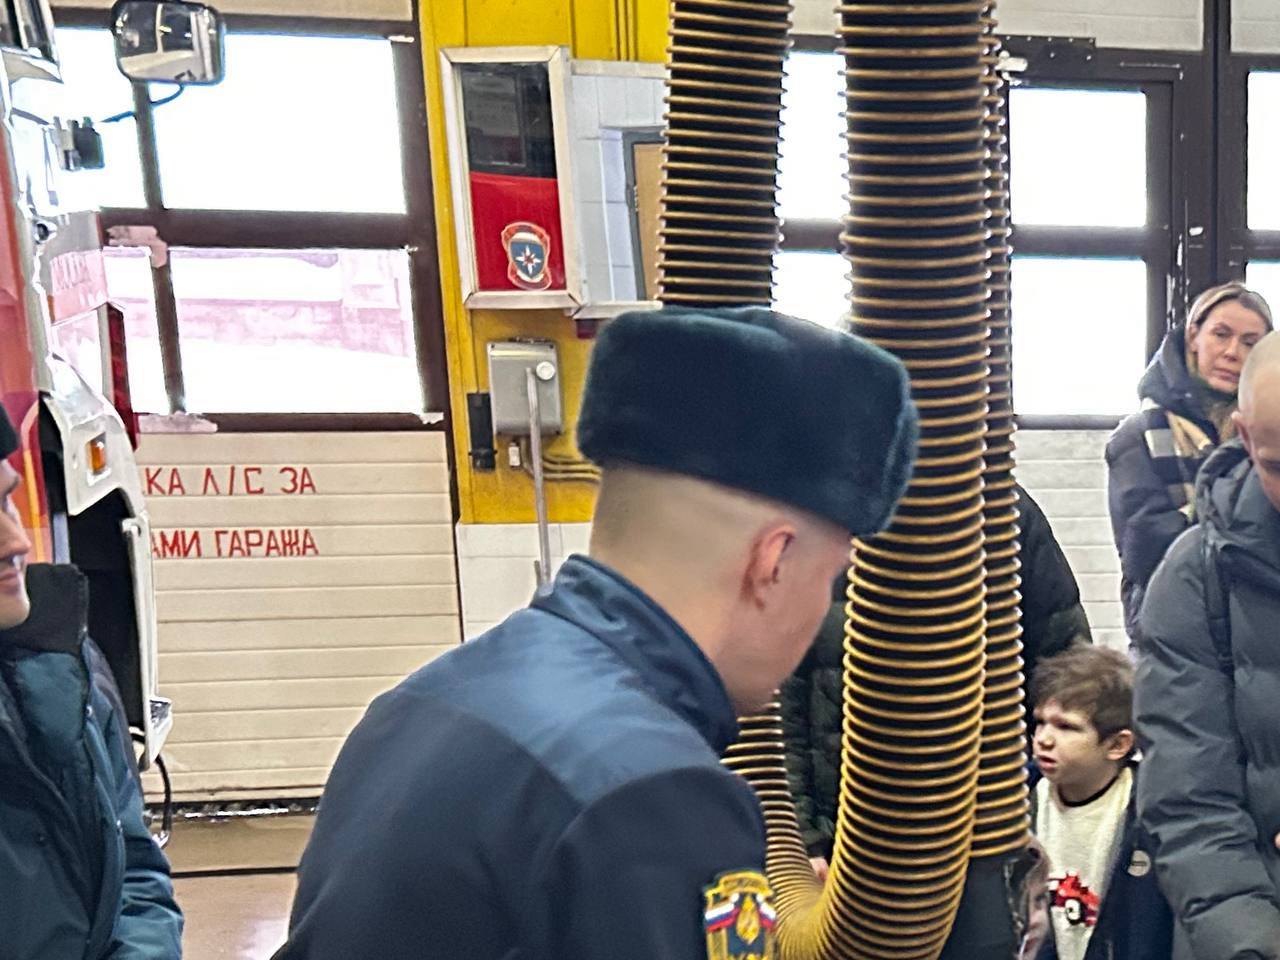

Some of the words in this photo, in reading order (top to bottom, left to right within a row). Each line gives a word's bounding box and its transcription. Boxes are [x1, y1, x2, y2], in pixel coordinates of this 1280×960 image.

[143, 467, 185, 495] КА
[203, 465, 264, 496] Л/С
[279, 466, 317, 494] ЗА
[214, 528, 320, 558] ГАРАЖА
